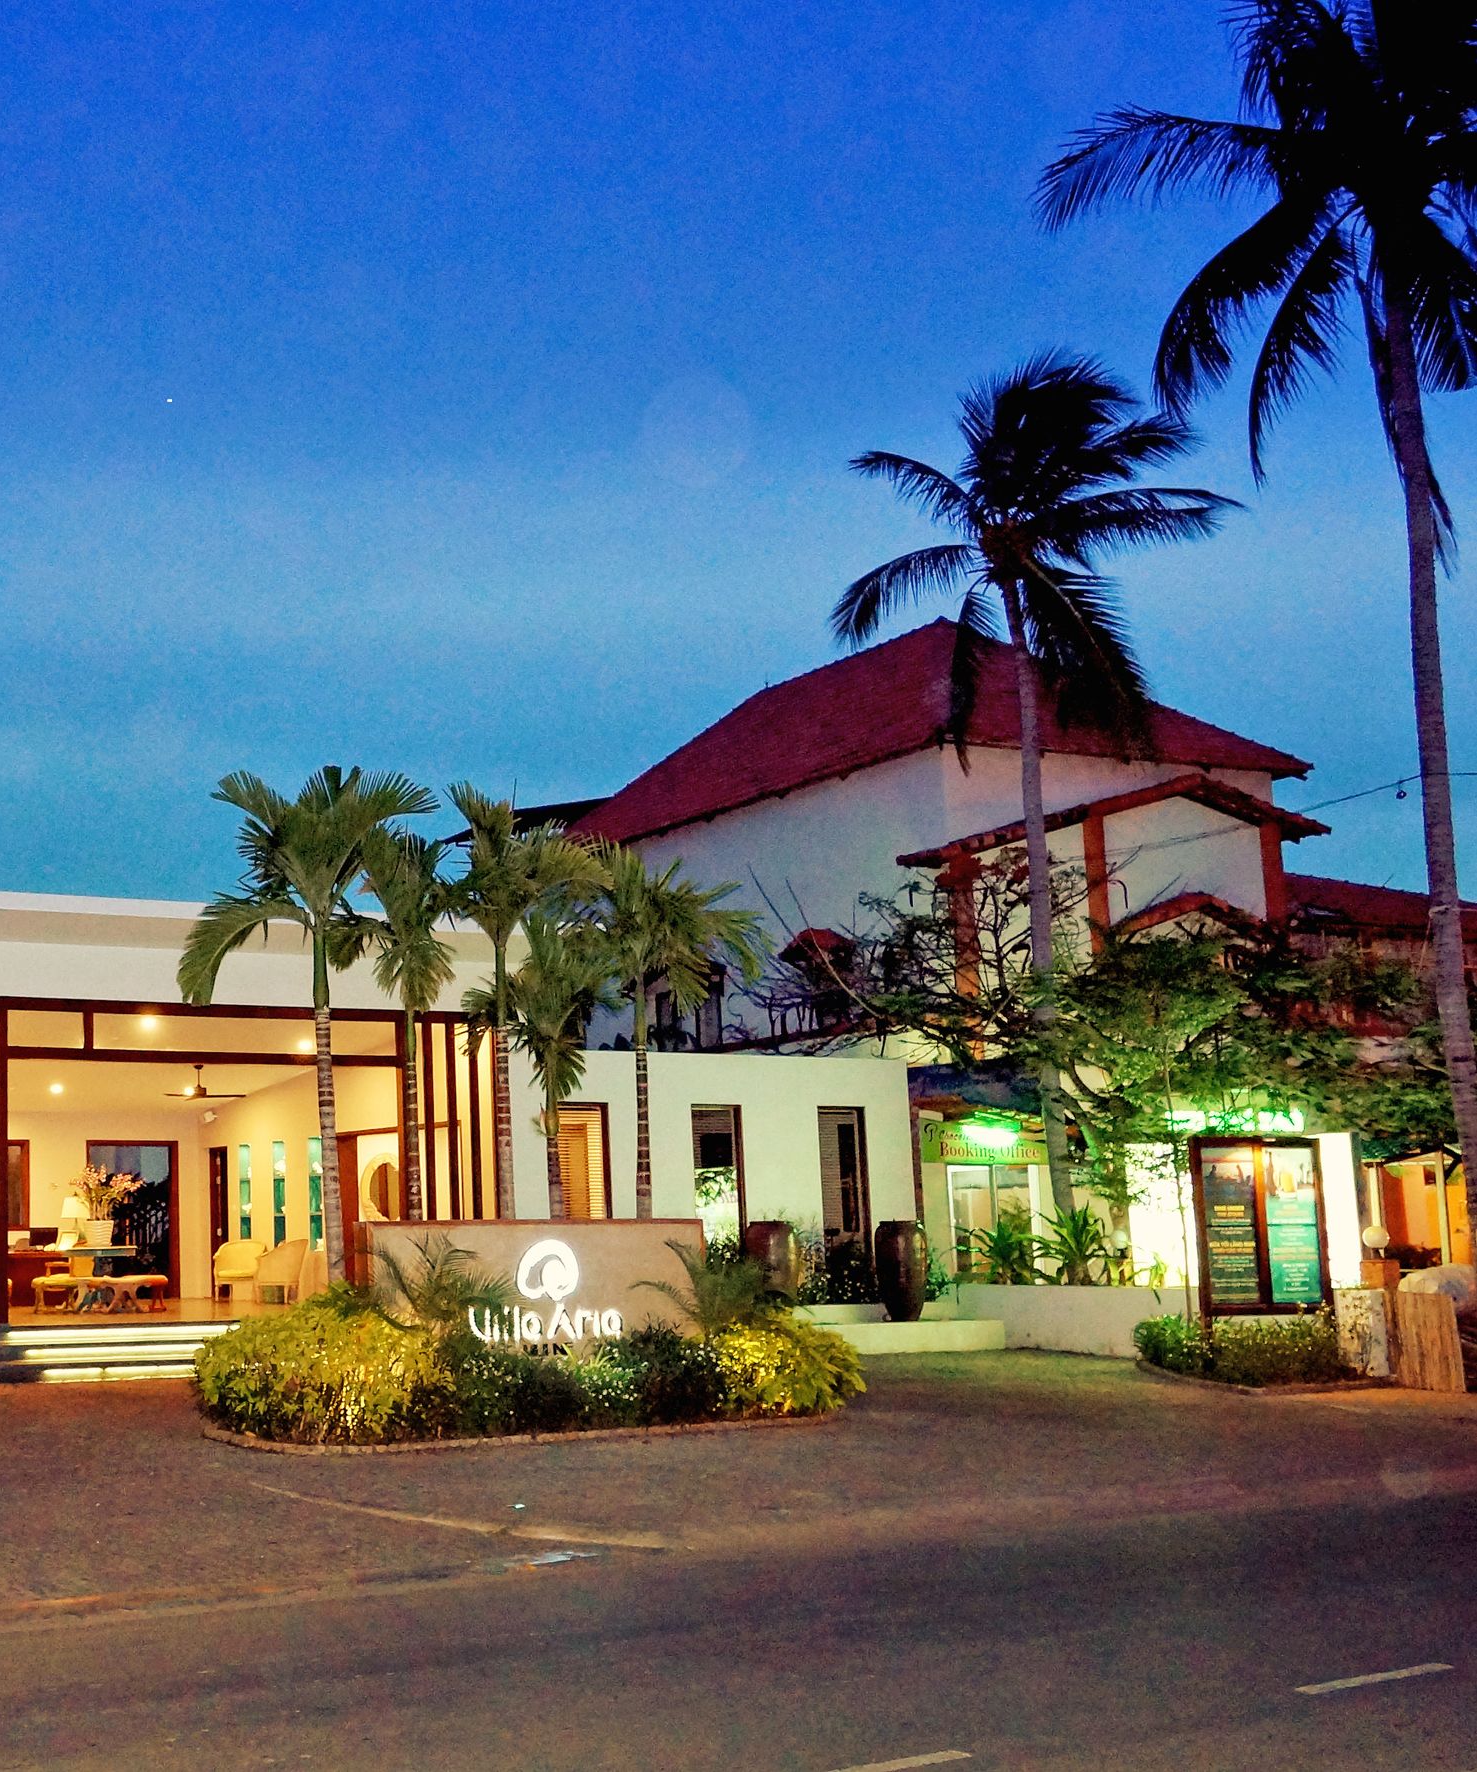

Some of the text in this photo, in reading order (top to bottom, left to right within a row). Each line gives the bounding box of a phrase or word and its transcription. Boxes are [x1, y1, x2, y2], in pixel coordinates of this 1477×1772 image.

[939, 1141, 1040, 1162] Booking Office
[468, 1302, 624, 1345] Villa Aria
